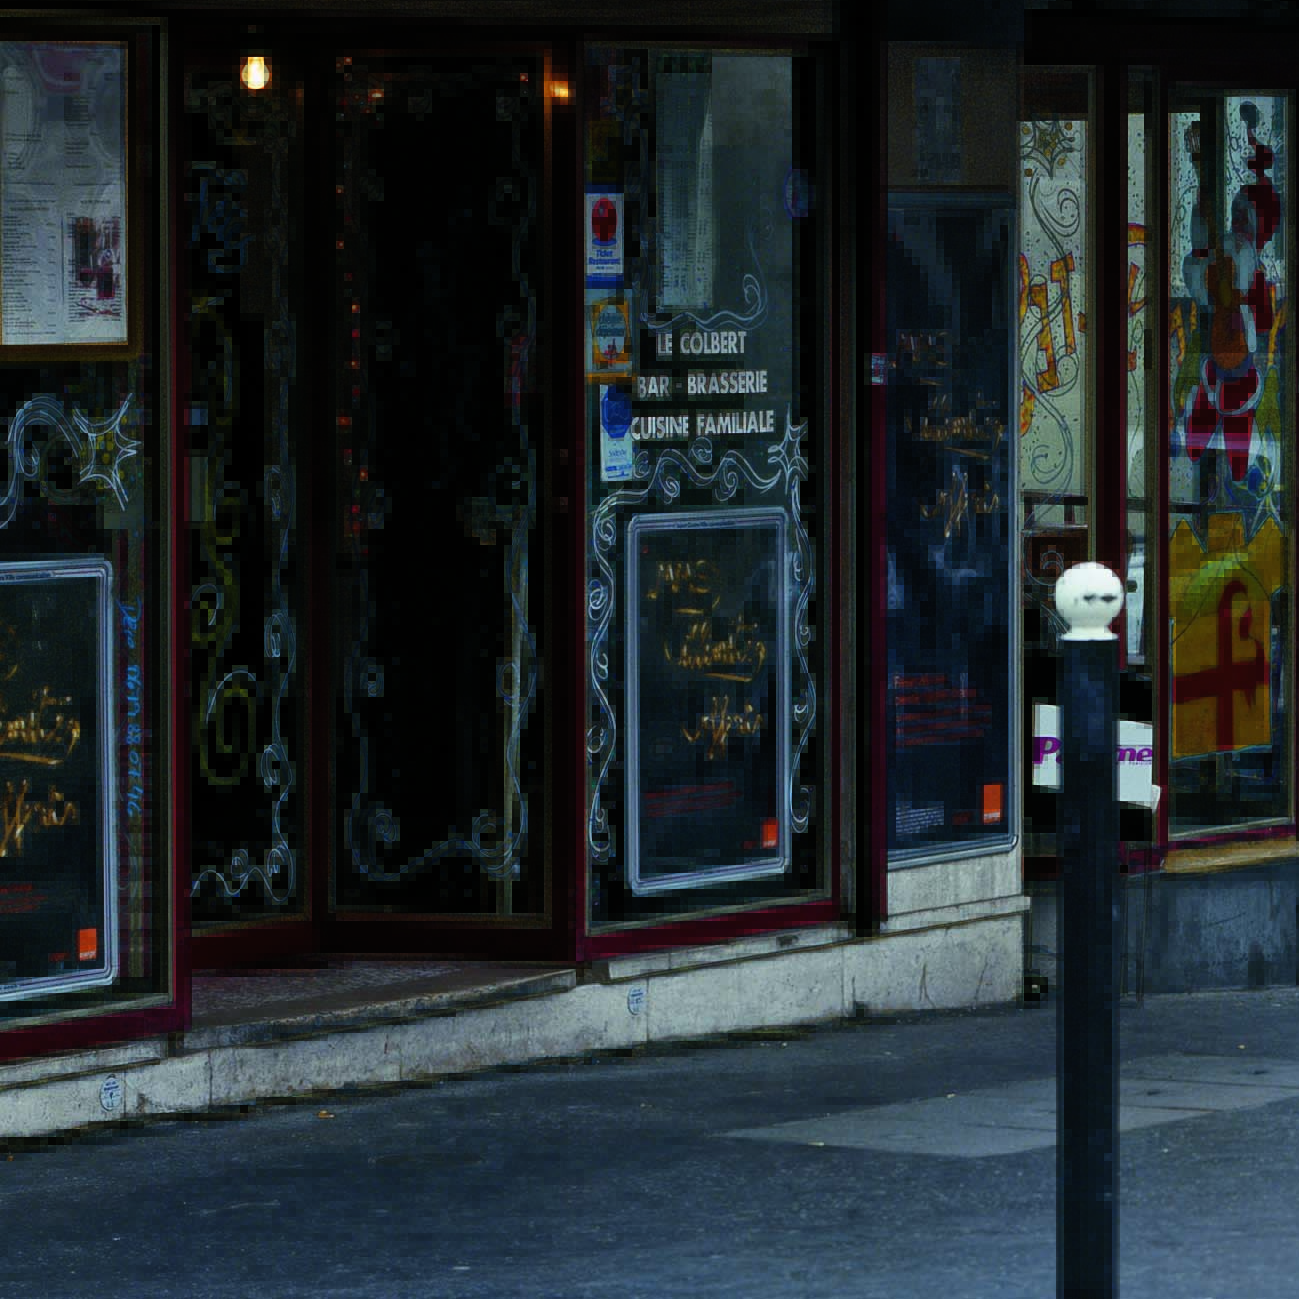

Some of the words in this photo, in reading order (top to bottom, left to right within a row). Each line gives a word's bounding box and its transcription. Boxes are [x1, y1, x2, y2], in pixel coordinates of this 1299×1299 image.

[656, 333, 673, 356] LE
[680, 331, 747, 354] COLBERT
[637, 375, 670, 398] BAR
[688, 370, 768, 394] BRASSERIE
[631, 415, 689, 440] CUISINE
[696, 409, 775, 436] FAMILIALE
